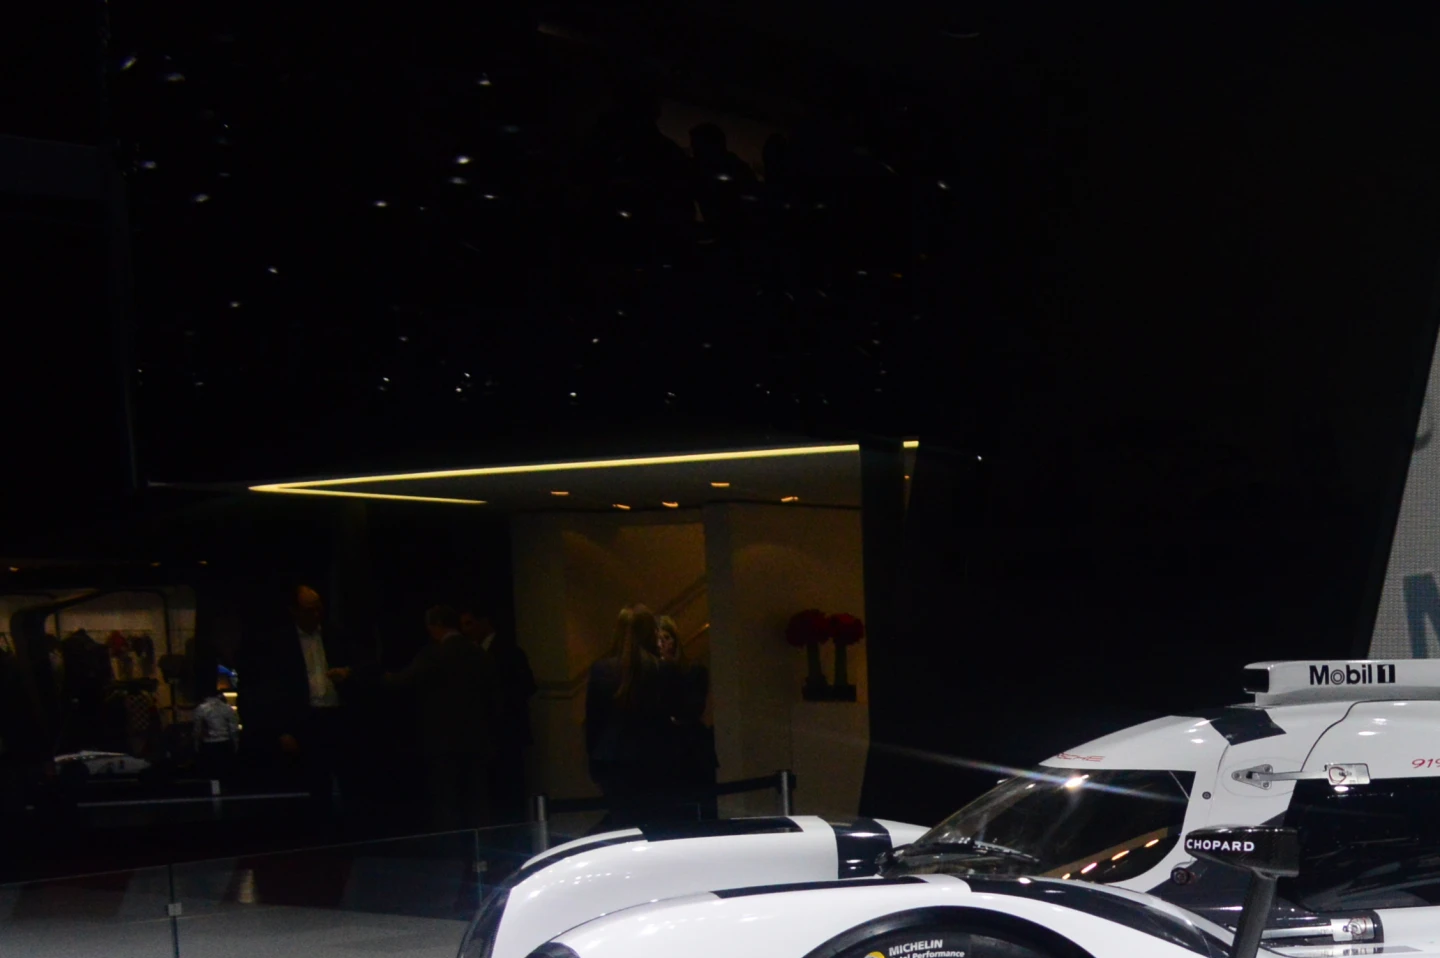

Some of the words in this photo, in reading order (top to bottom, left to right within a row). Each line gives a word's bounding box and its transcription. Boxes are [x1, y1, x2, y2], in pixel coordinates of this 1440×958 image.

[1308, 664, 1373, 686] Mobil
[1186, 838, 1255, 852] CHOPARD
[889, 939, 944, 956] MICHELIN
